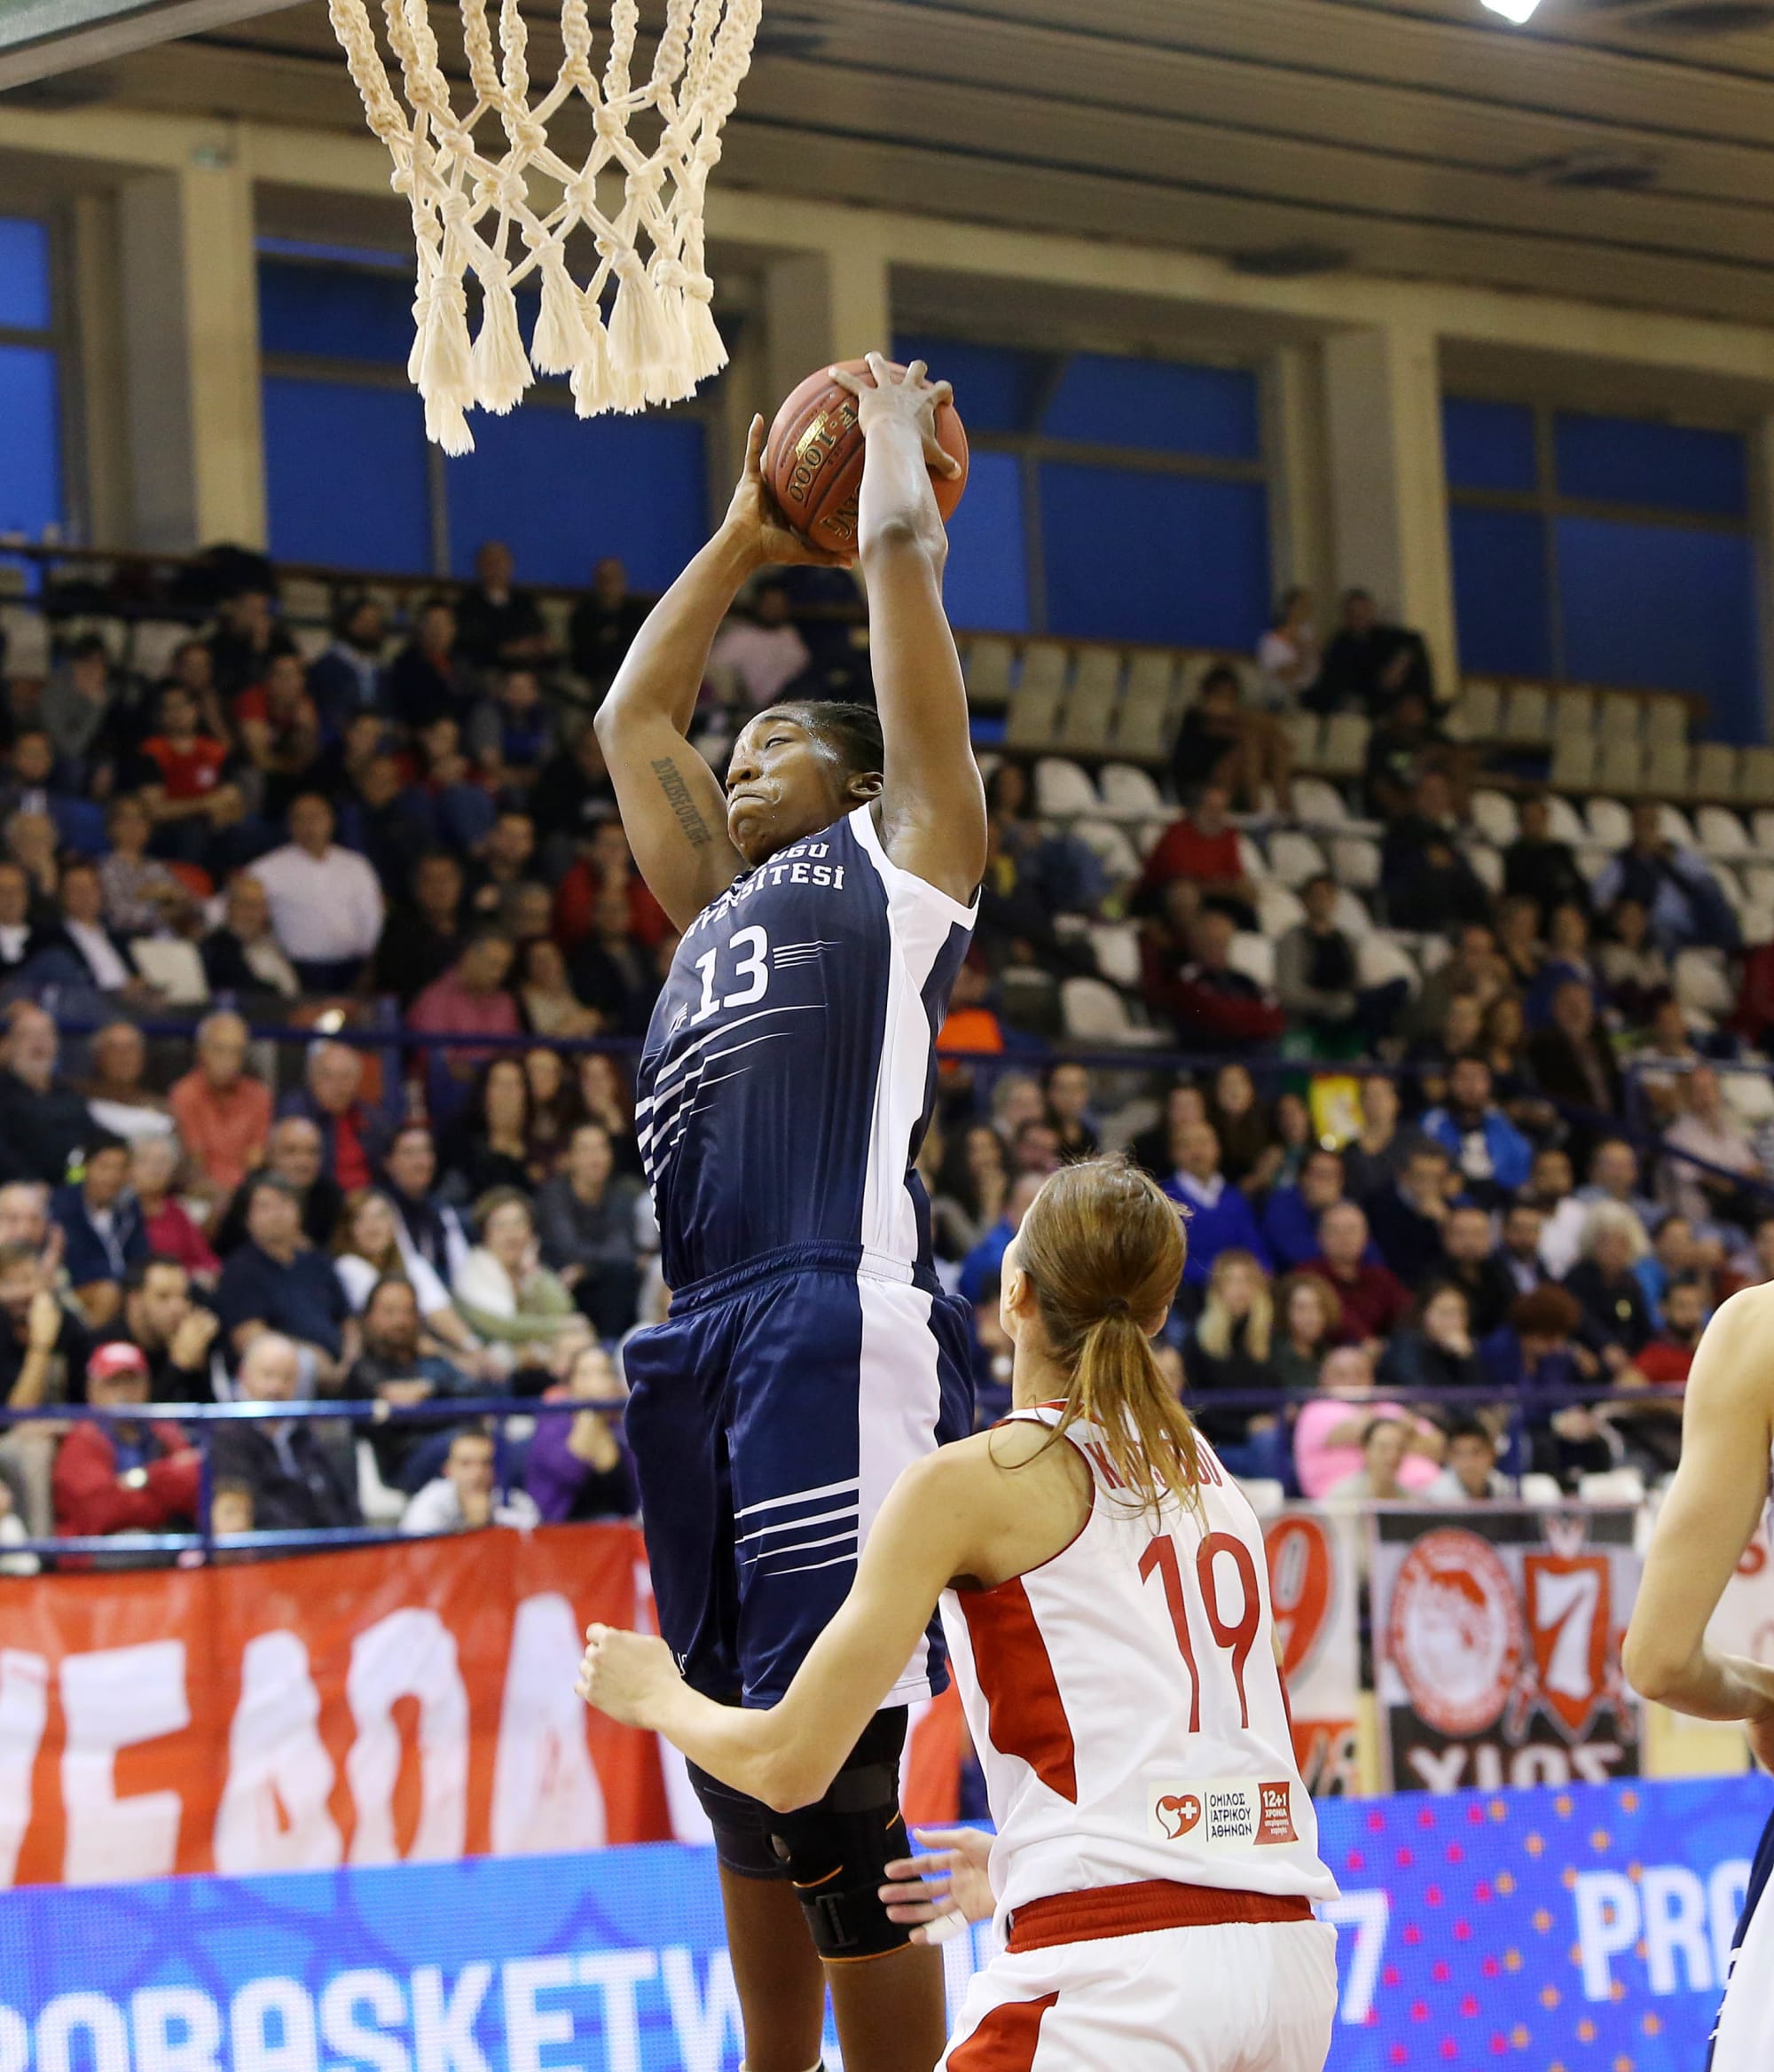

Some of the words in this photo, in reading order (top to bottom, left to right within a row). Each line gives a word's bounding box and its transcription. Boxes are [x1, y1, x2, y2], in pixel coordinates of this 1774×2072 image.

[690, 925, 768, 1026] 13
[1138, 1532, 1260, 1733] 19
[1535, 1569, 1600, 1702] 7
[1210, 1793, 1245, 1807] ΟΜΙΛΟΣ
[1210, 1808, 1251, 1824] ΙΑΤΡΙΚΟΥ
[1263, 1790, 1287, 1808] 12+1
[1212, 1824, 1252, 1838] ΑΘΗΝΩΝ
[0, 1944, 750, 2072] OBASKETW
